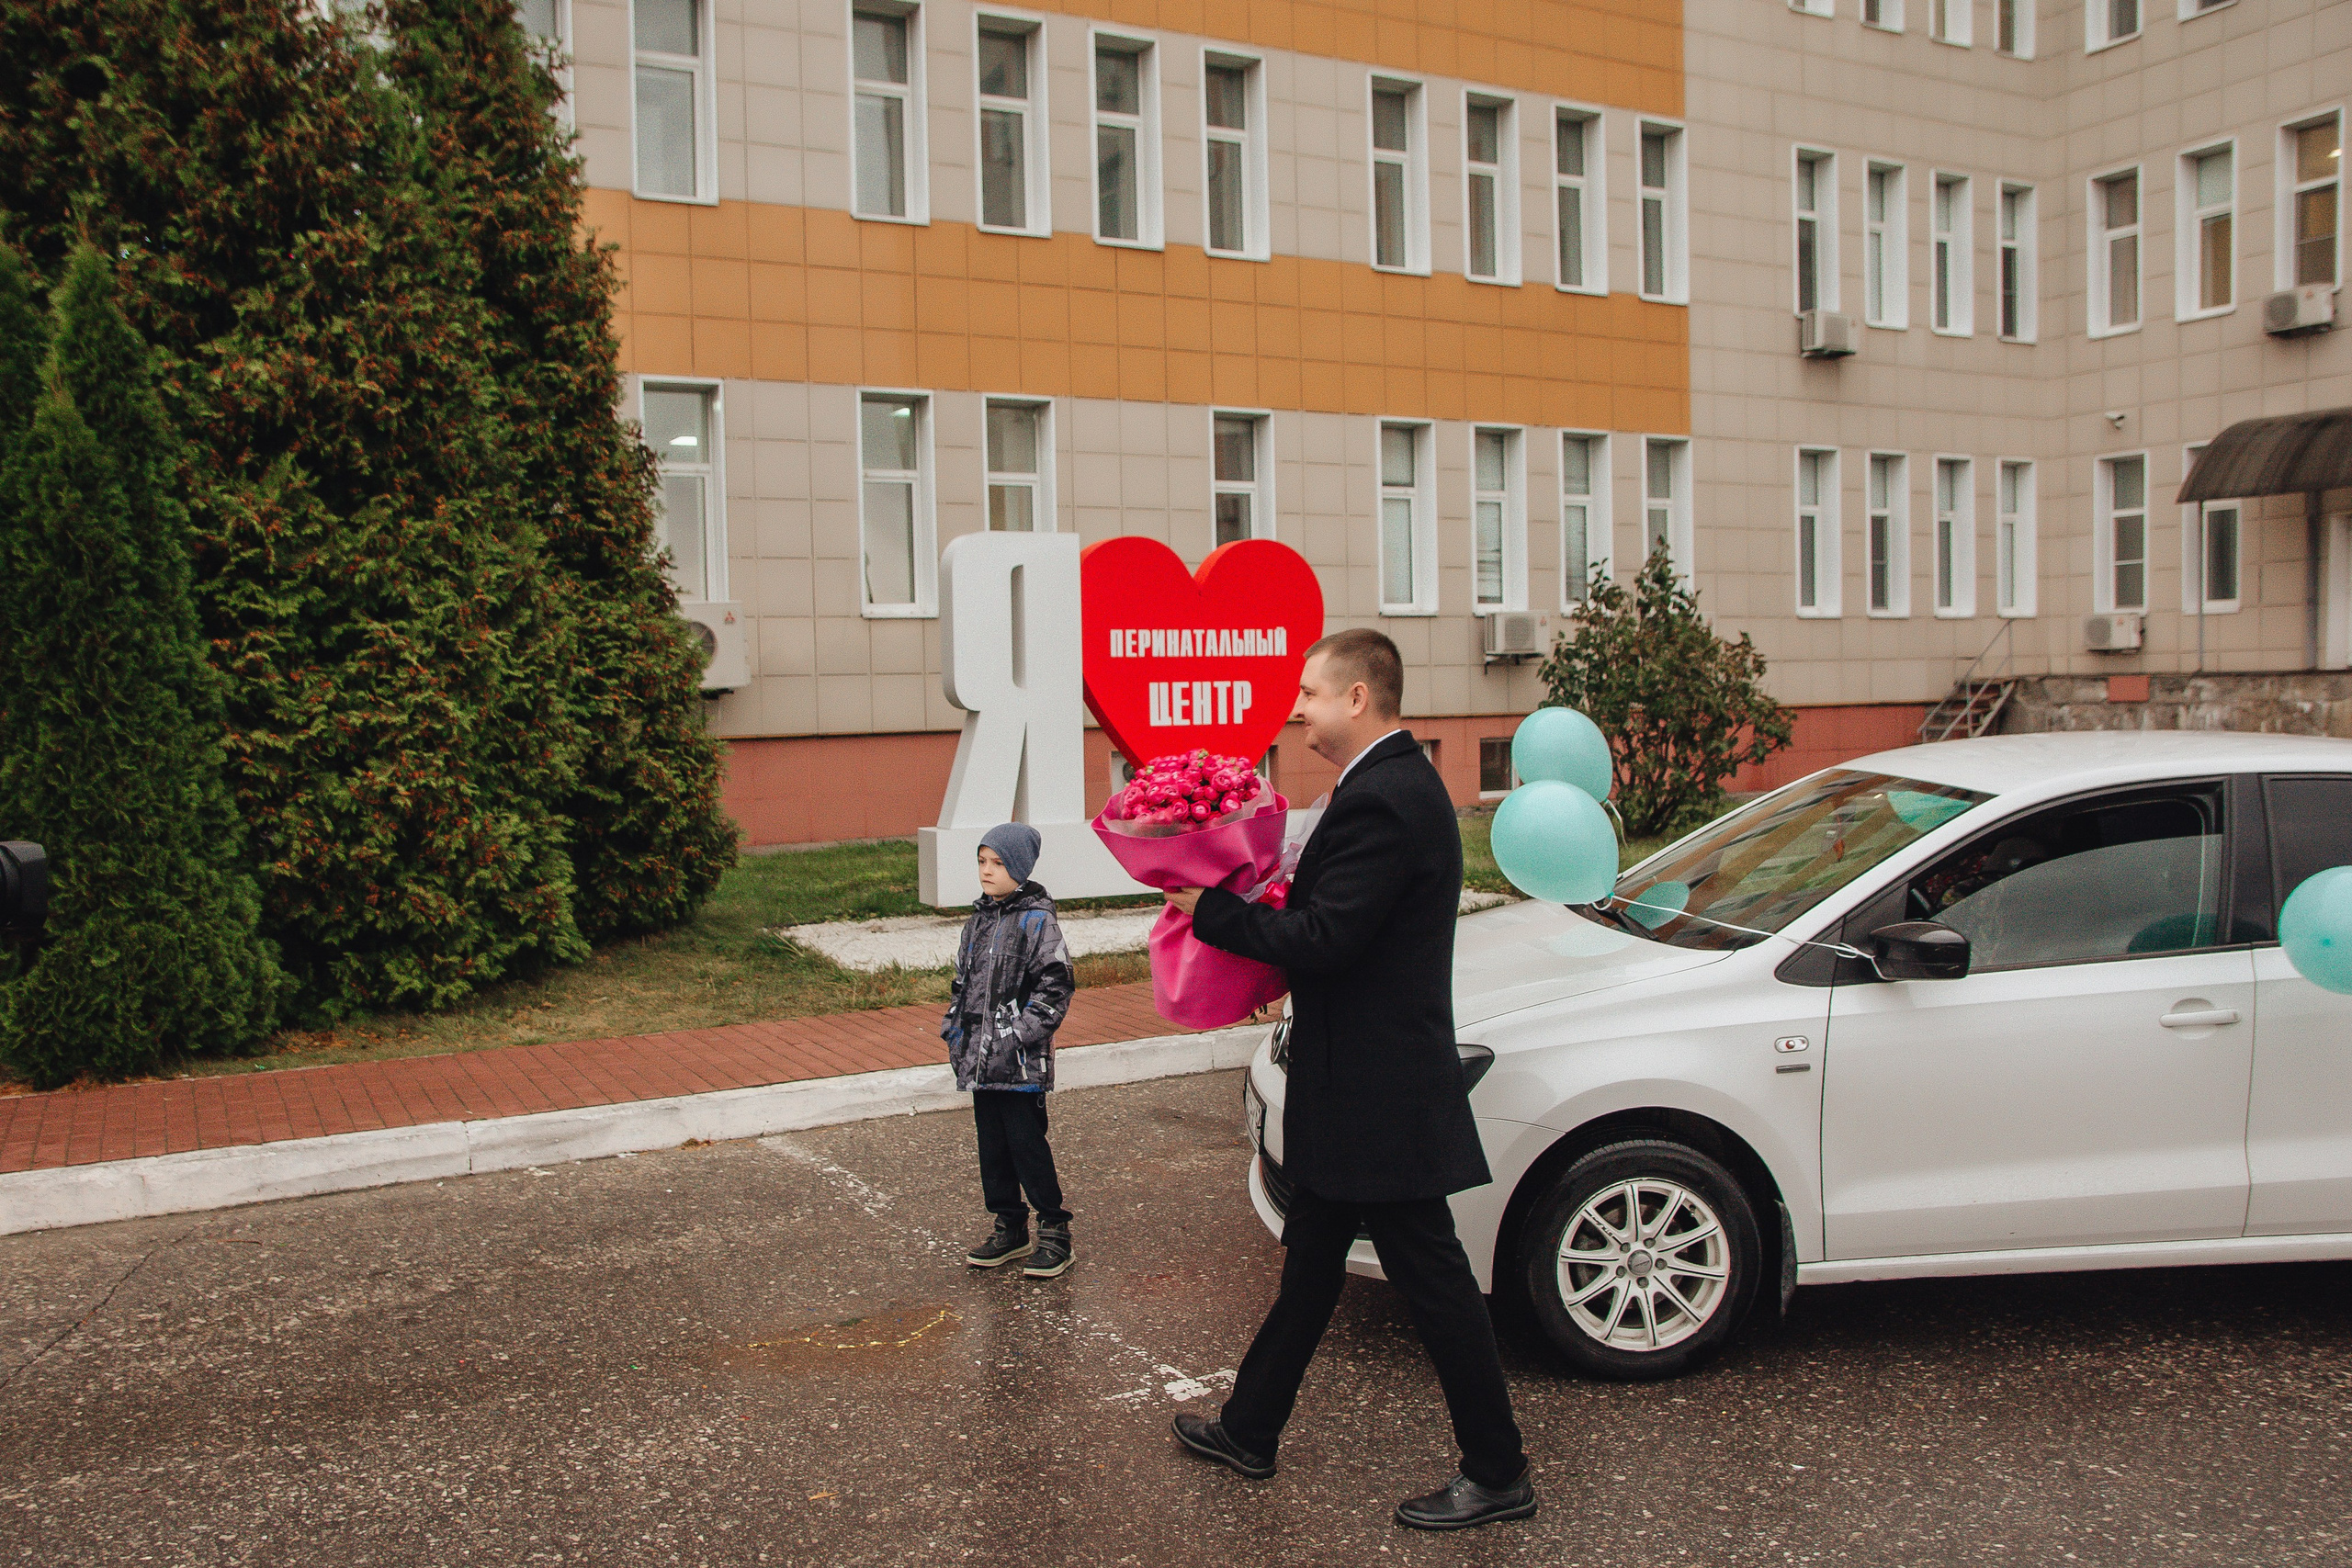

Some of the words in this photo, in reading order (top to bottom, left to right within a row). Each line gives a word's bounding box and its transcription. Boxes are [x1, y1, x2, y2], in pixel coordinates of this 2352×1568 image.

[1110, 626, 1287, 658] ПЕРИНАТАЛЬНЫЙ
[939, 531, 1085, 829] Я
[1148, 680, 1252, 727] ЦЕНТР
